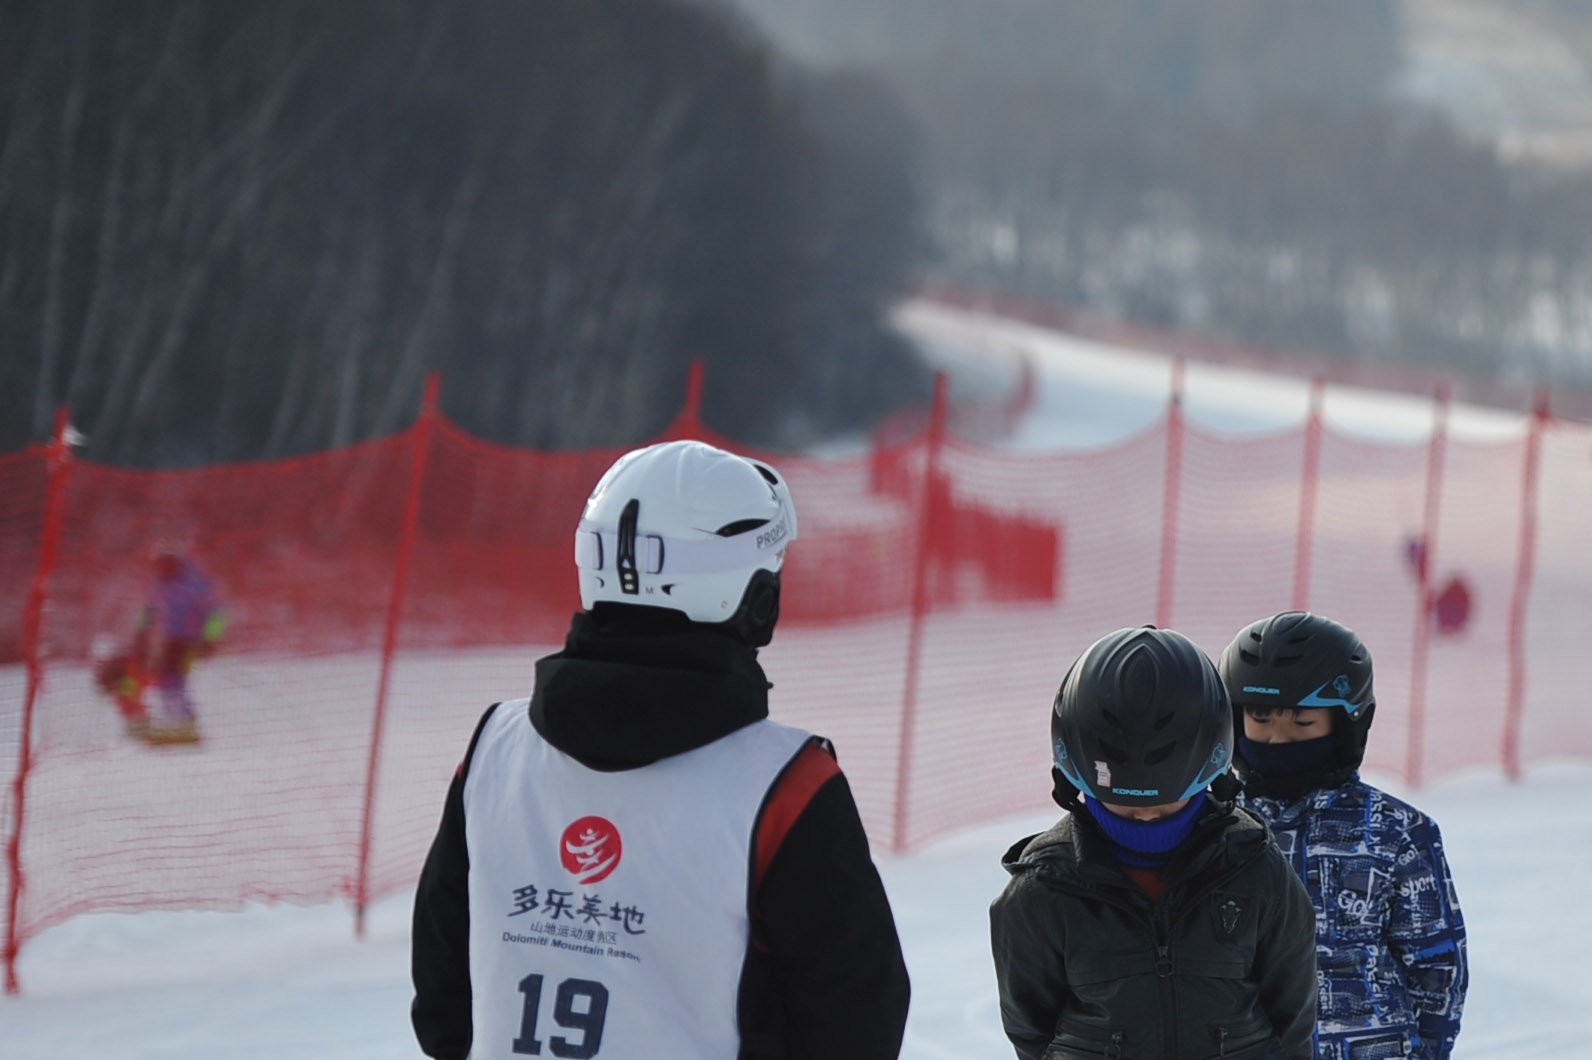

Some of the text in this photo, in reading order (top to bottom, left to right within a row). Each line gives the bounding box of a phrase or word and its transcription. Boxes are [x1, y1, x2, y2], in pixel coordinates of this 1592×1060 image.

[1112, 787, 1159, 797] KONQUER
[507, 884, 646, 936] 多乐美地
[551, 938, 605, 957] Mountain
